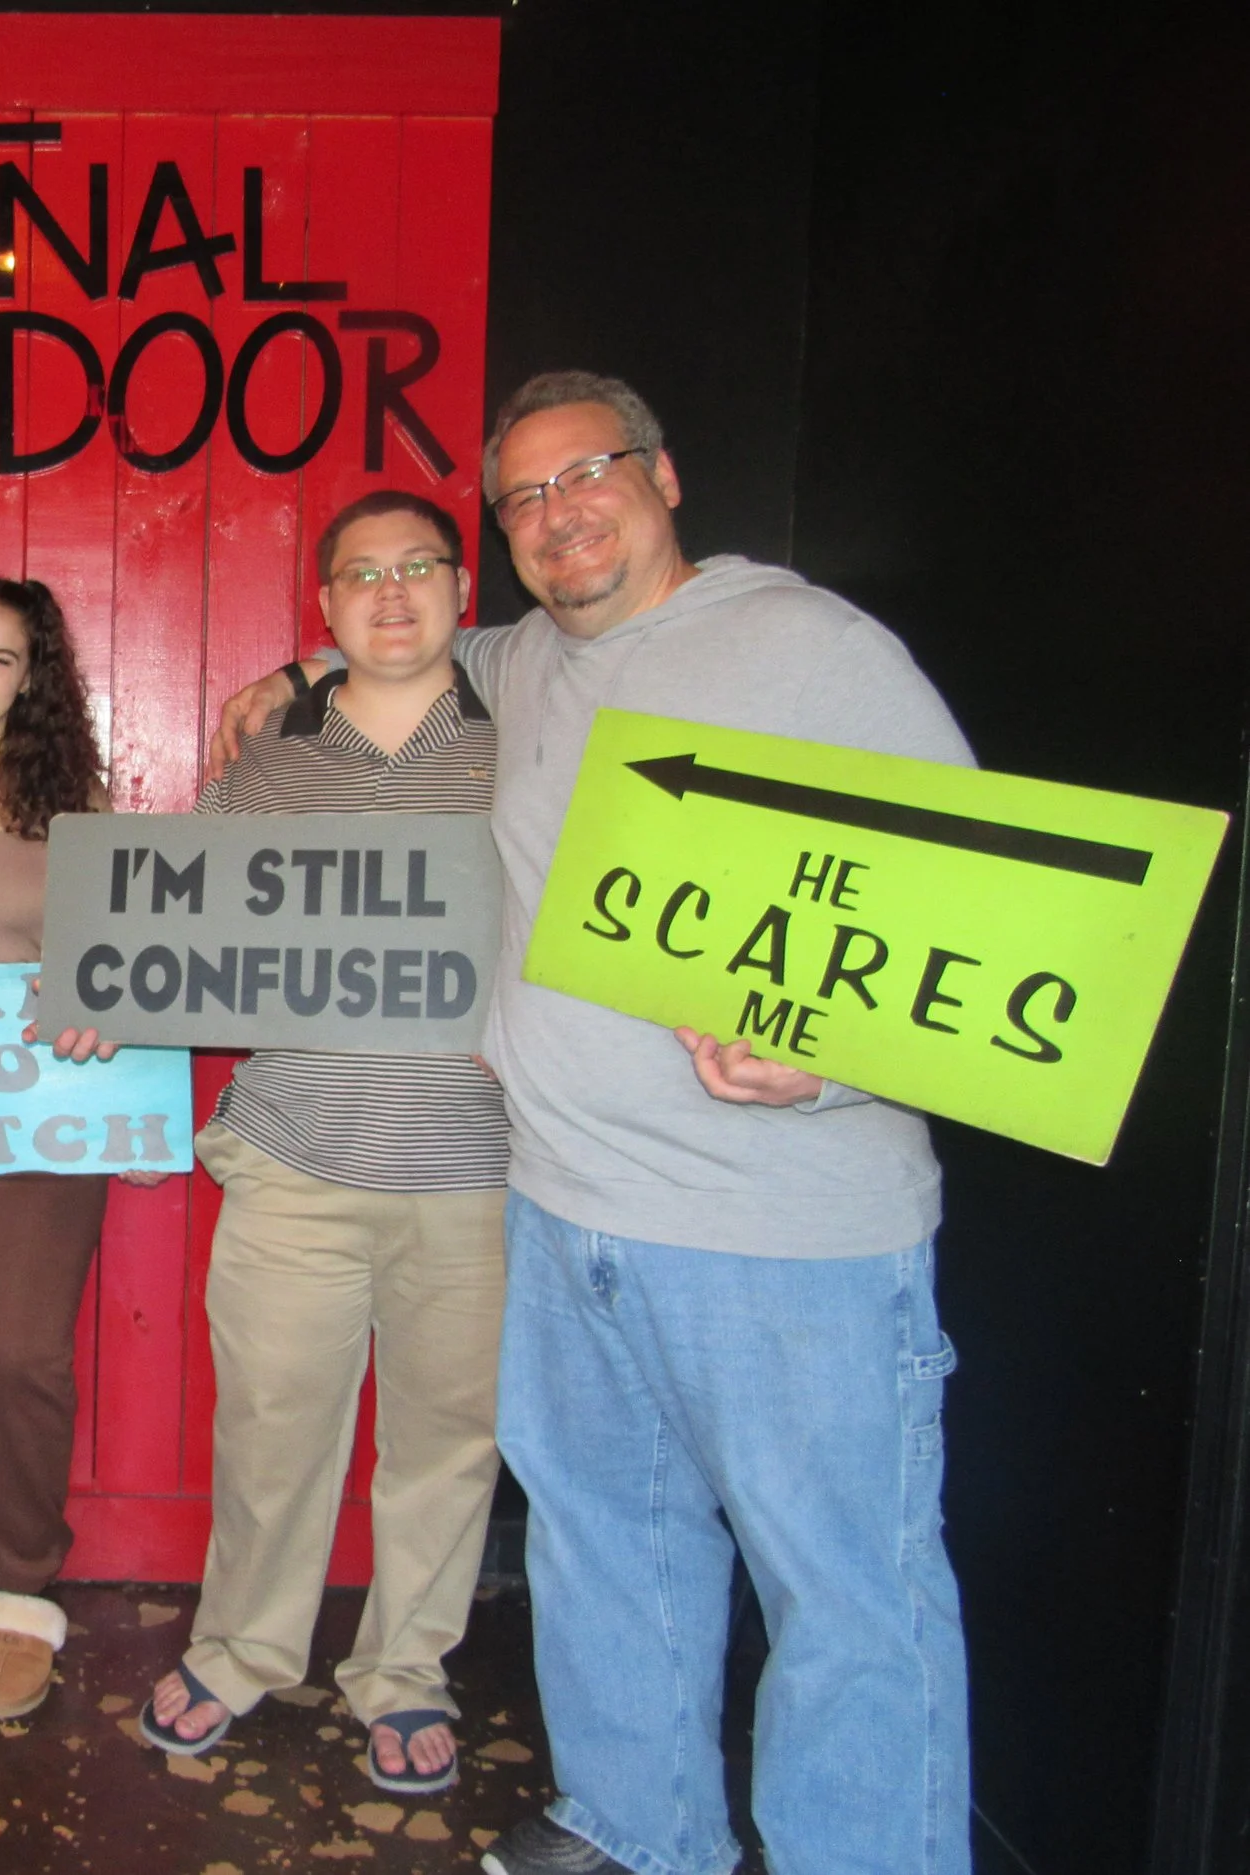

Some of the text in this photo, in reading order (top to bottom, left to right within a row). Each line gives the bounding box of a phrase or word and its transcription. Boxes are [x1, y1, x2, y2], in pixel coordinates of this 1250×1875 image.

[109, 848, 446, 917] I'M STILL
[789, 851, 870, 911] HE
[76, 943, 477, 1019] CONFUSED
[582, 866, 1077, 1064] SCARES
[735, 990, 828, 1058] ME
